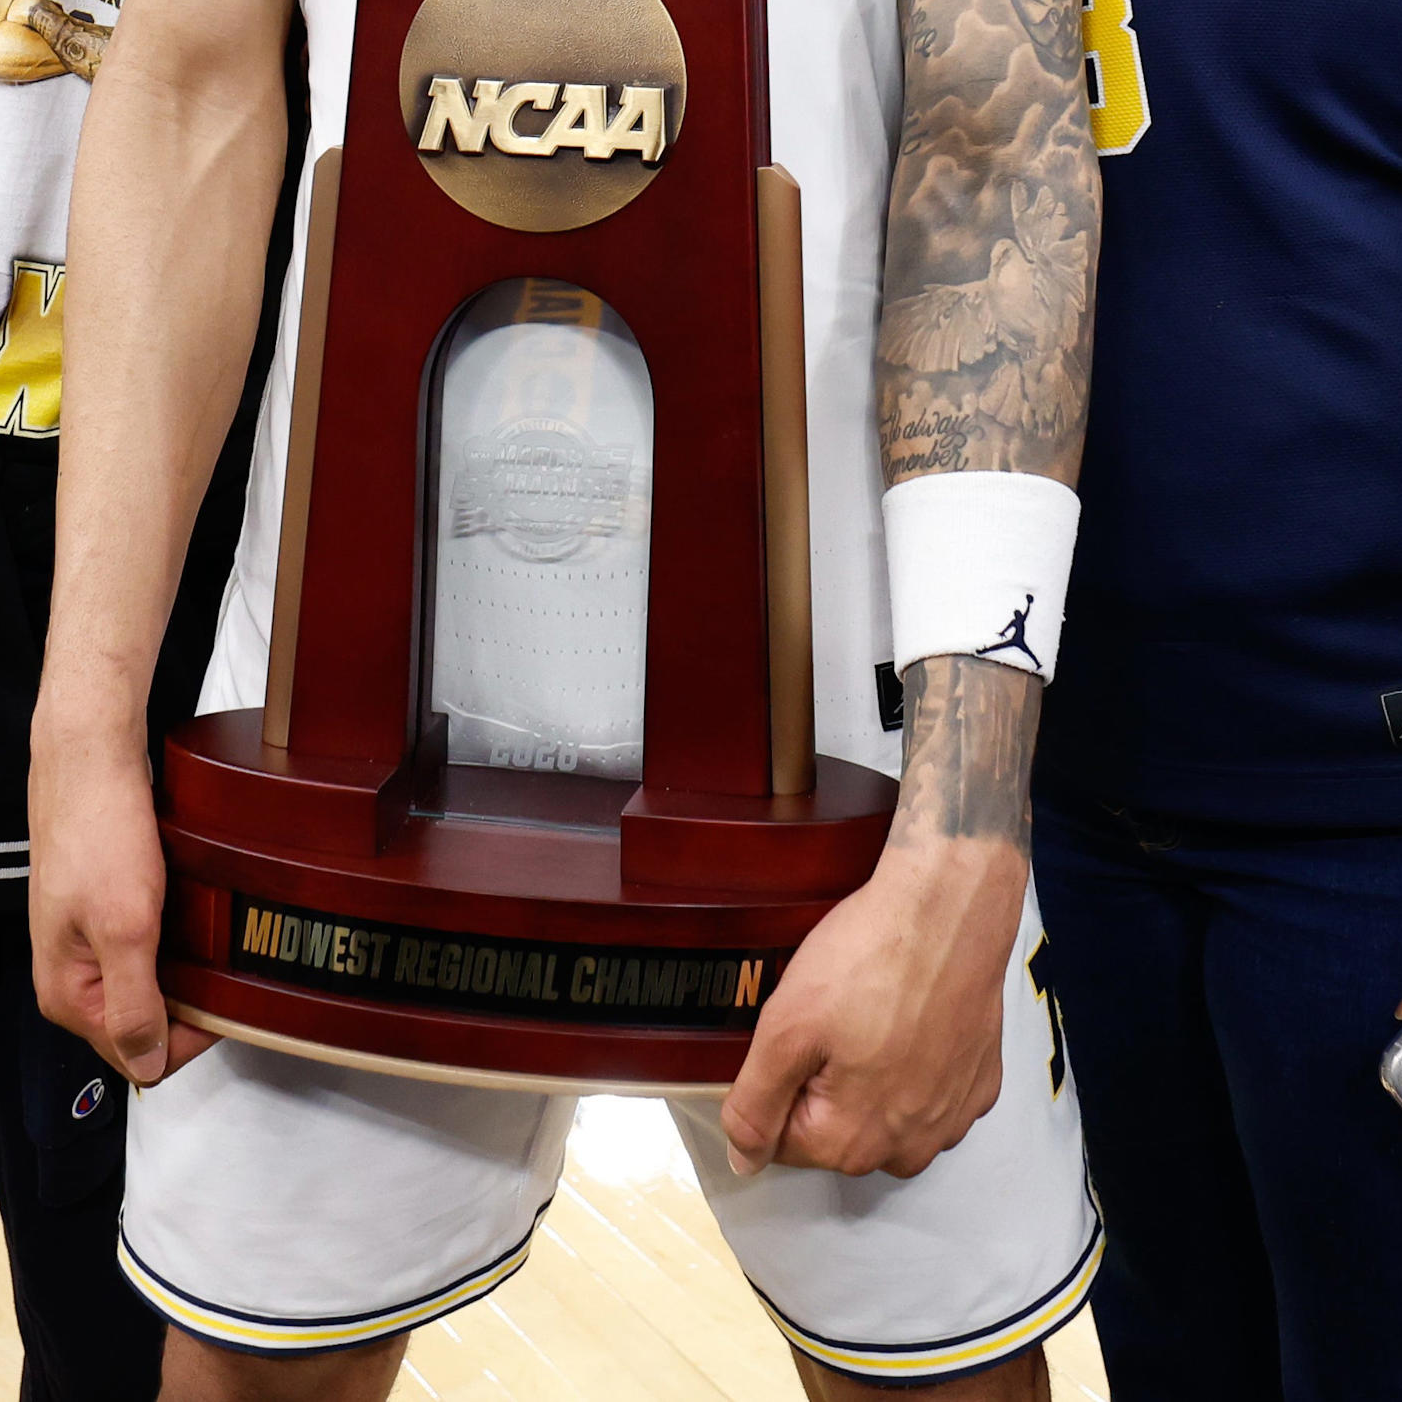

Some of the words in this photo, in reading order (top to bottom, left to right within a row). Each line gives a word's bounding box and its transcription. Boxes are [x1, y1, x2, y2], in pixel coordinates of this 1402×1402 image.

[417, 76, 669, 166] NCAA
[241, 907, 391, 981] MIDWEST
[394, 936, 560, 1003] REGIONAL
[569, 955, 764, 1010] CHAMPION
